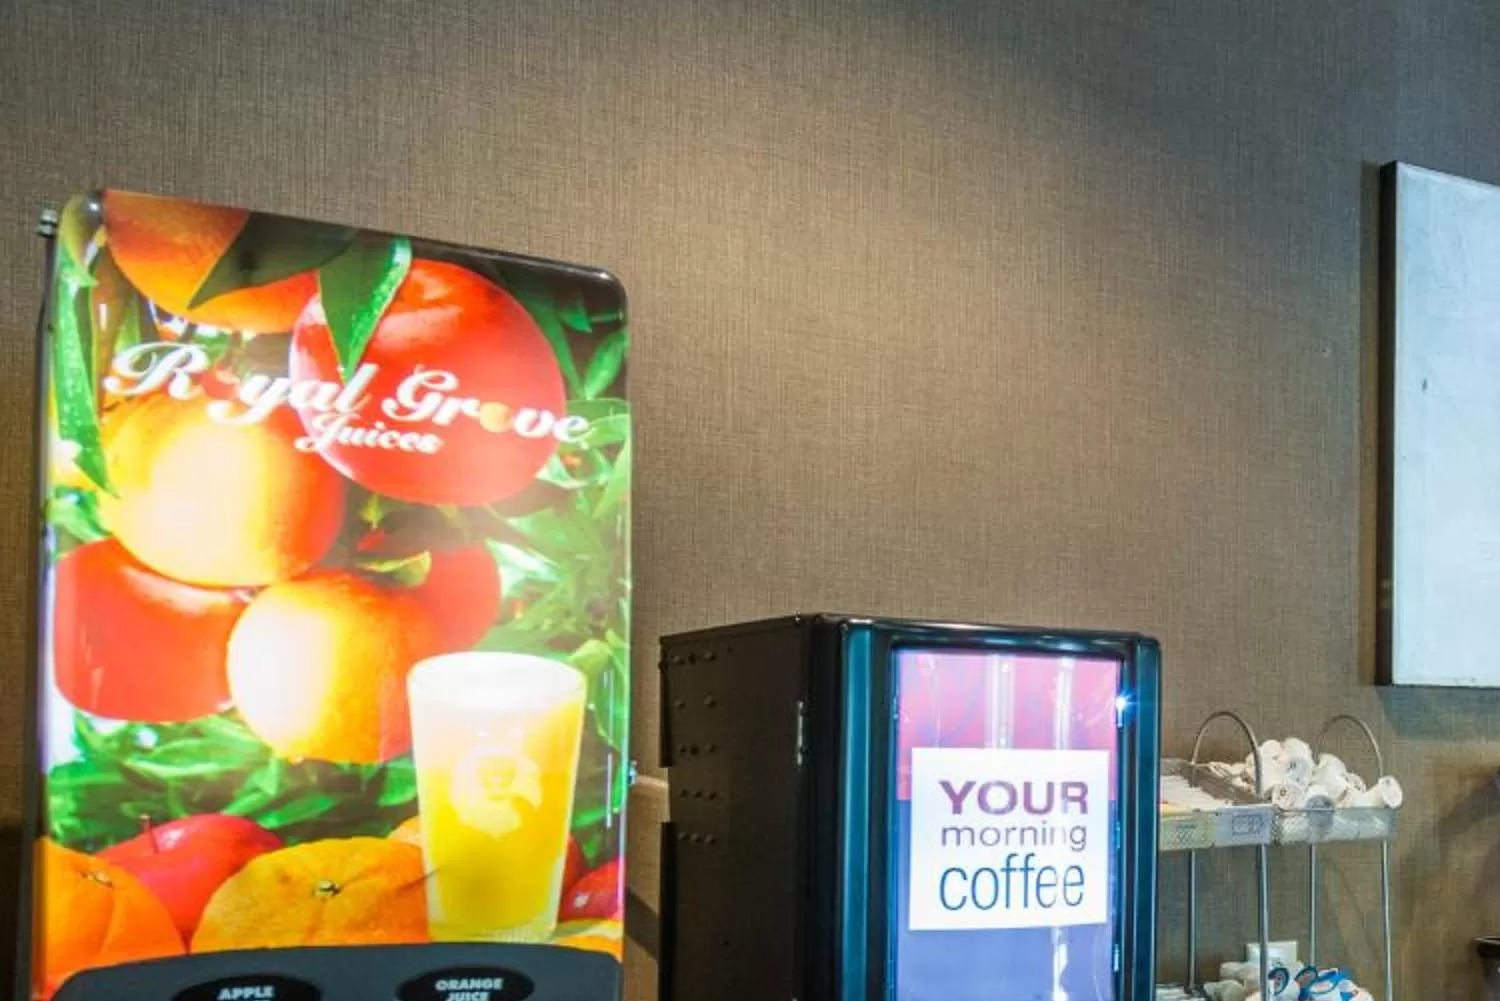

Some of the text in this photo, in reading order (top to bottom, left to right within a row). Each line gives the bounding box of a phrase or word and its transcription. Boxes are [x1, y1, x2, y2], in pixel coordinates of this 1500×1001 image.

[103, 341, 595, 449] Royal Grove
[293, 413, 444, 454] Juices
[938, 780, 1090, 816] YOUR
[941, 821, 1088, 852] morning
[939, 852, 1086, 911] coffee
[217, 985, 275, 1000] APPLE
[435, 977, 503, 991] ORANGE
